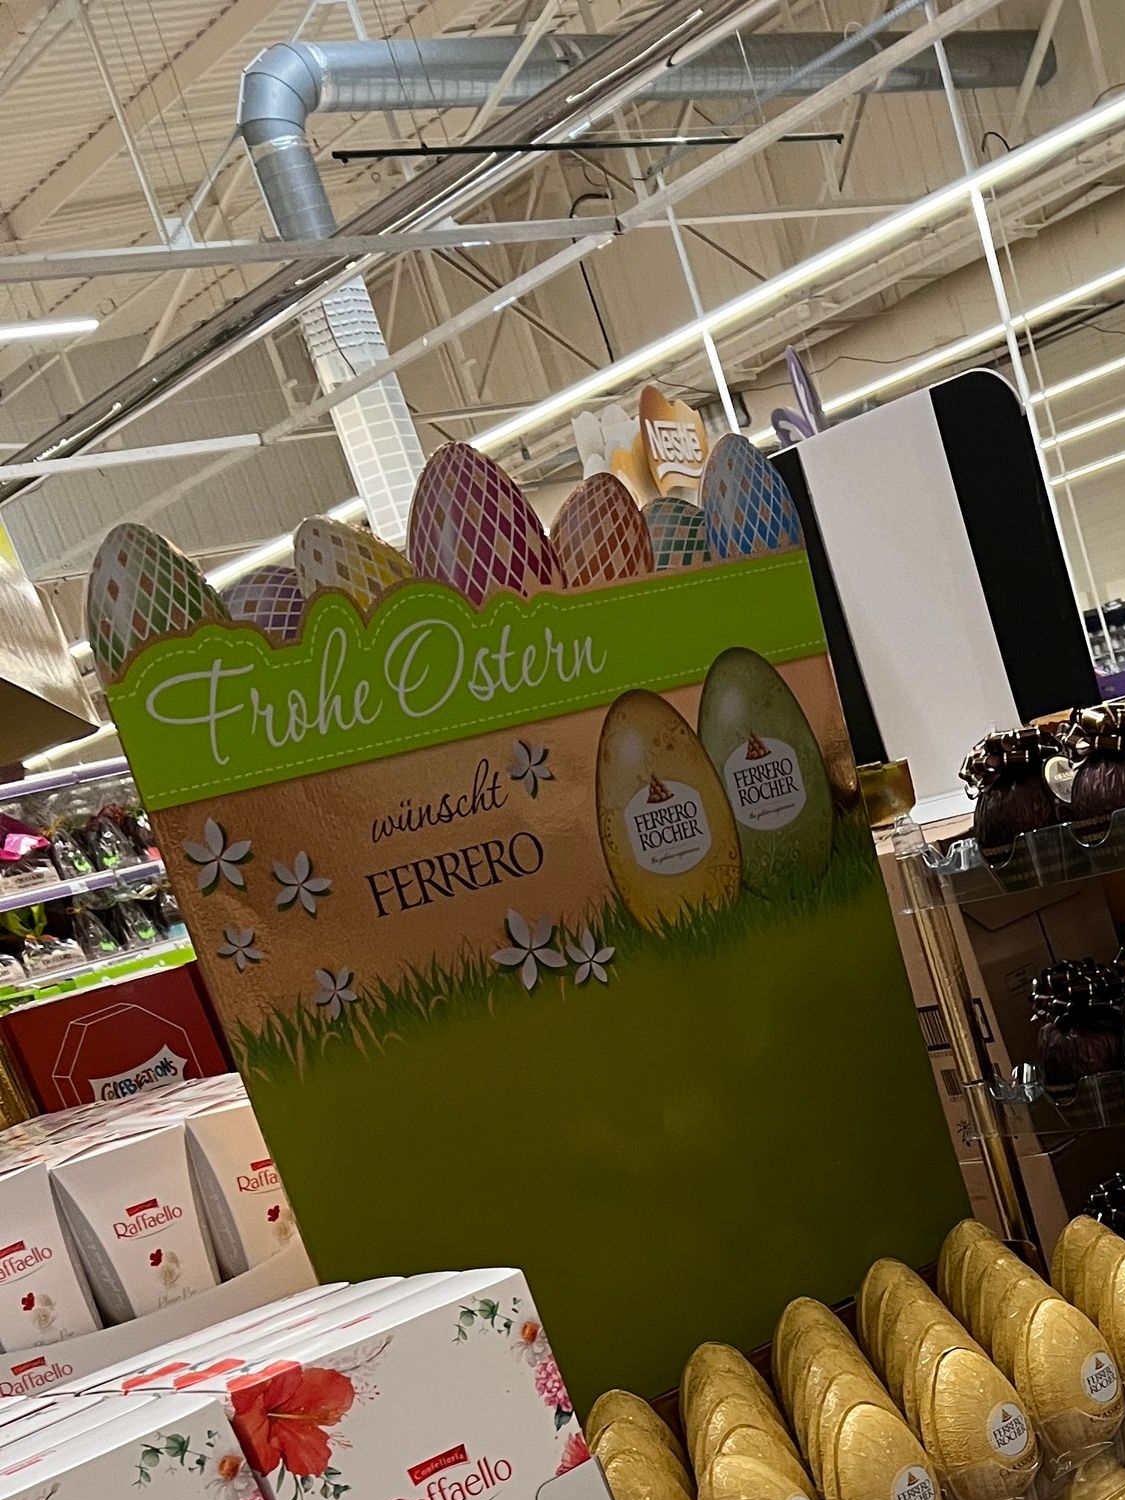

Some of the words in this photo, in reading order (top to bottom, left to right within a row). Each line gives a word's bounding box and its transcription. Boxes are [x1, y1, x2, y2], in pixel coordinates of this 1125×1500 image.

[145, 626, 384, 767] Frohe
[383, 617, 607, 719] Ostern
[733, 757, 794, 789] FERRERO
[371, 758, 512, 846] wünscht
[738, 776, 800, 807] ROCHER
[634, 800, 698, 834] FERRERO
[639, 819, 704, 852] ROCHER
[364, 831, 546, 919] FERRERO
[236, 1168, 279, 1193] Raffa
[113, 1205, 183, 1240] Raffaello
[0, 1246, 53, 1281] affaello
